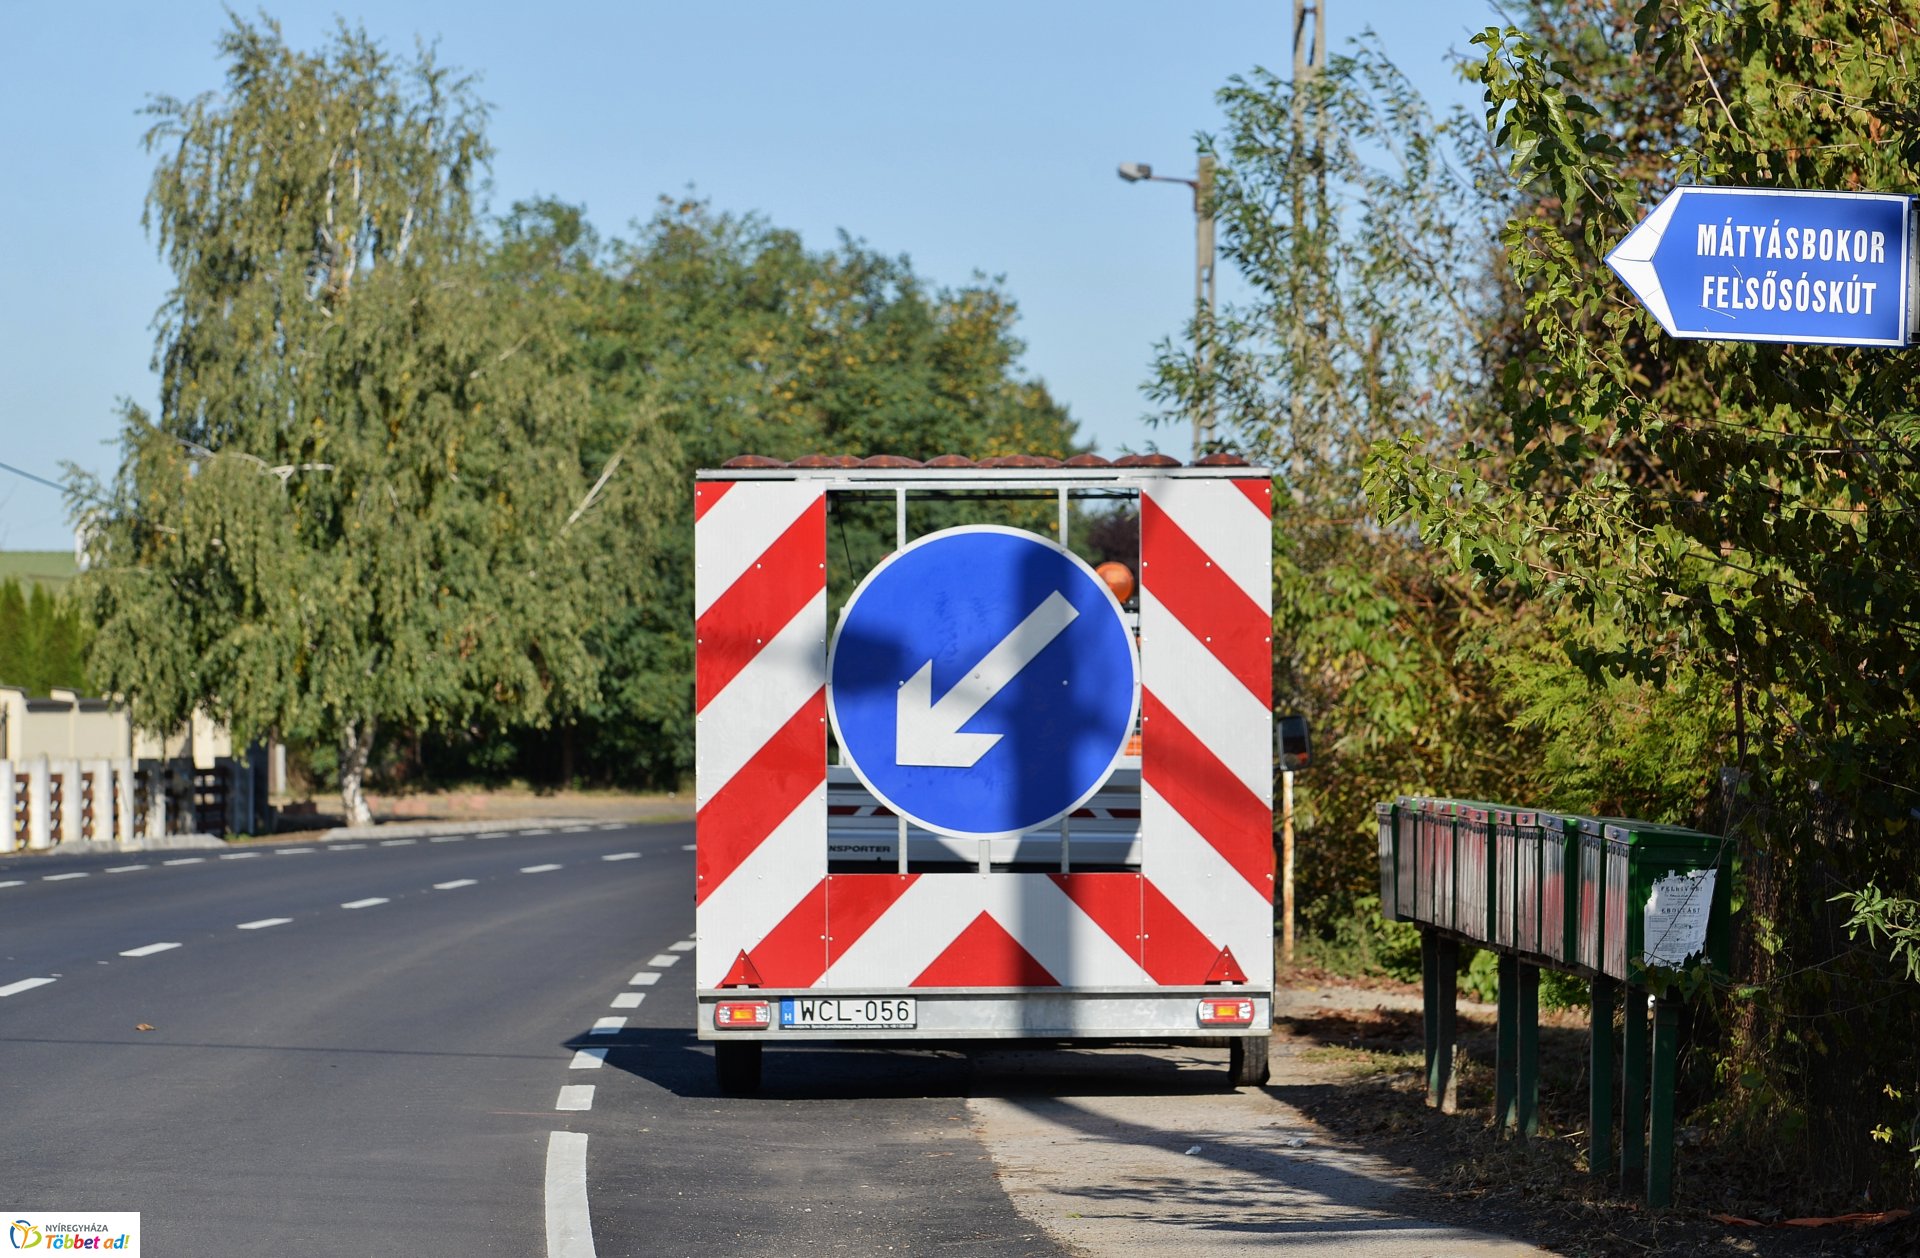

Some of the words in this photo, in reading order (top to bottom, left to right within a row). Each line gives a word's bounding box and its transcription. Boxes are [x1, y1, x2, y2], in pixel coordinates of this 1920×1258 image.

[1697, 217, 1885, 264] MÁTYÁSBOKOR
[1702, 270, 1877, 315] FELSŐSÓSKÚT
[784, 1013, 792, 1021] H
[801, 1000, 909, 1021] WCL-056
